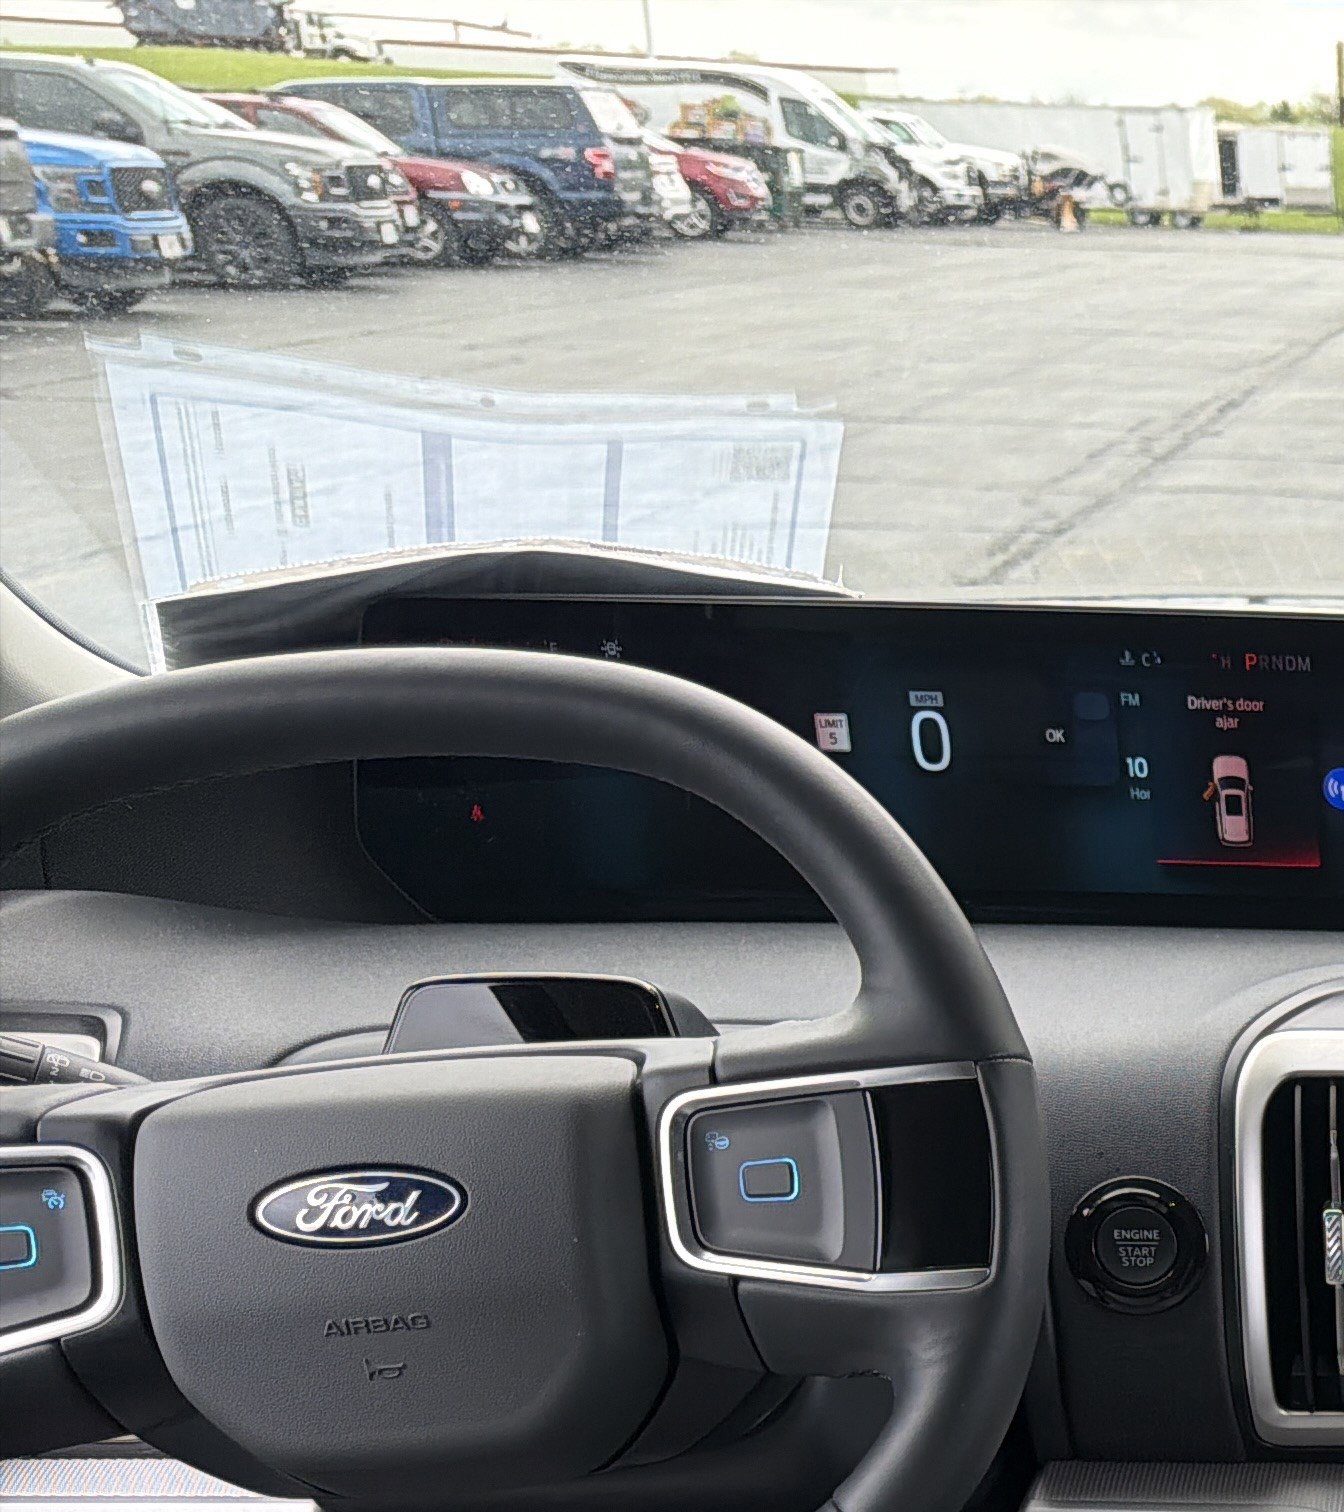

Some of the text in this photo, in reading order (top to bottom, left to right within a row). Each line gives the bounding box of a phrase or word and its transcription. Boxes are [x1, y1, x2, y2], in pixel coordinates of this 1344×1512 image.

[914, 694, 939, 705] MPH
[1120, 691, 1141, 707] FM
[1187, 695, 1264, 712] Driver's door
[819, 718, 844, 729] LIMIT
[1215, 715, 1239, 731] ajar
[828, 732, 838, 745] 5
[911, 710, 951, 772] 0
[1045, 728, 1066, 744] OK
[1126, 756, 1149, 778] 10
[296, 1181, 423, 1233] Ford
[1113, 1229, 1161, 1240] ENGINE
[1118, 1247, 1157, 1257] START
[1122, 1257, 1155, 1267] STOP
[323, 1313, 432, 1338] AIRBAG
